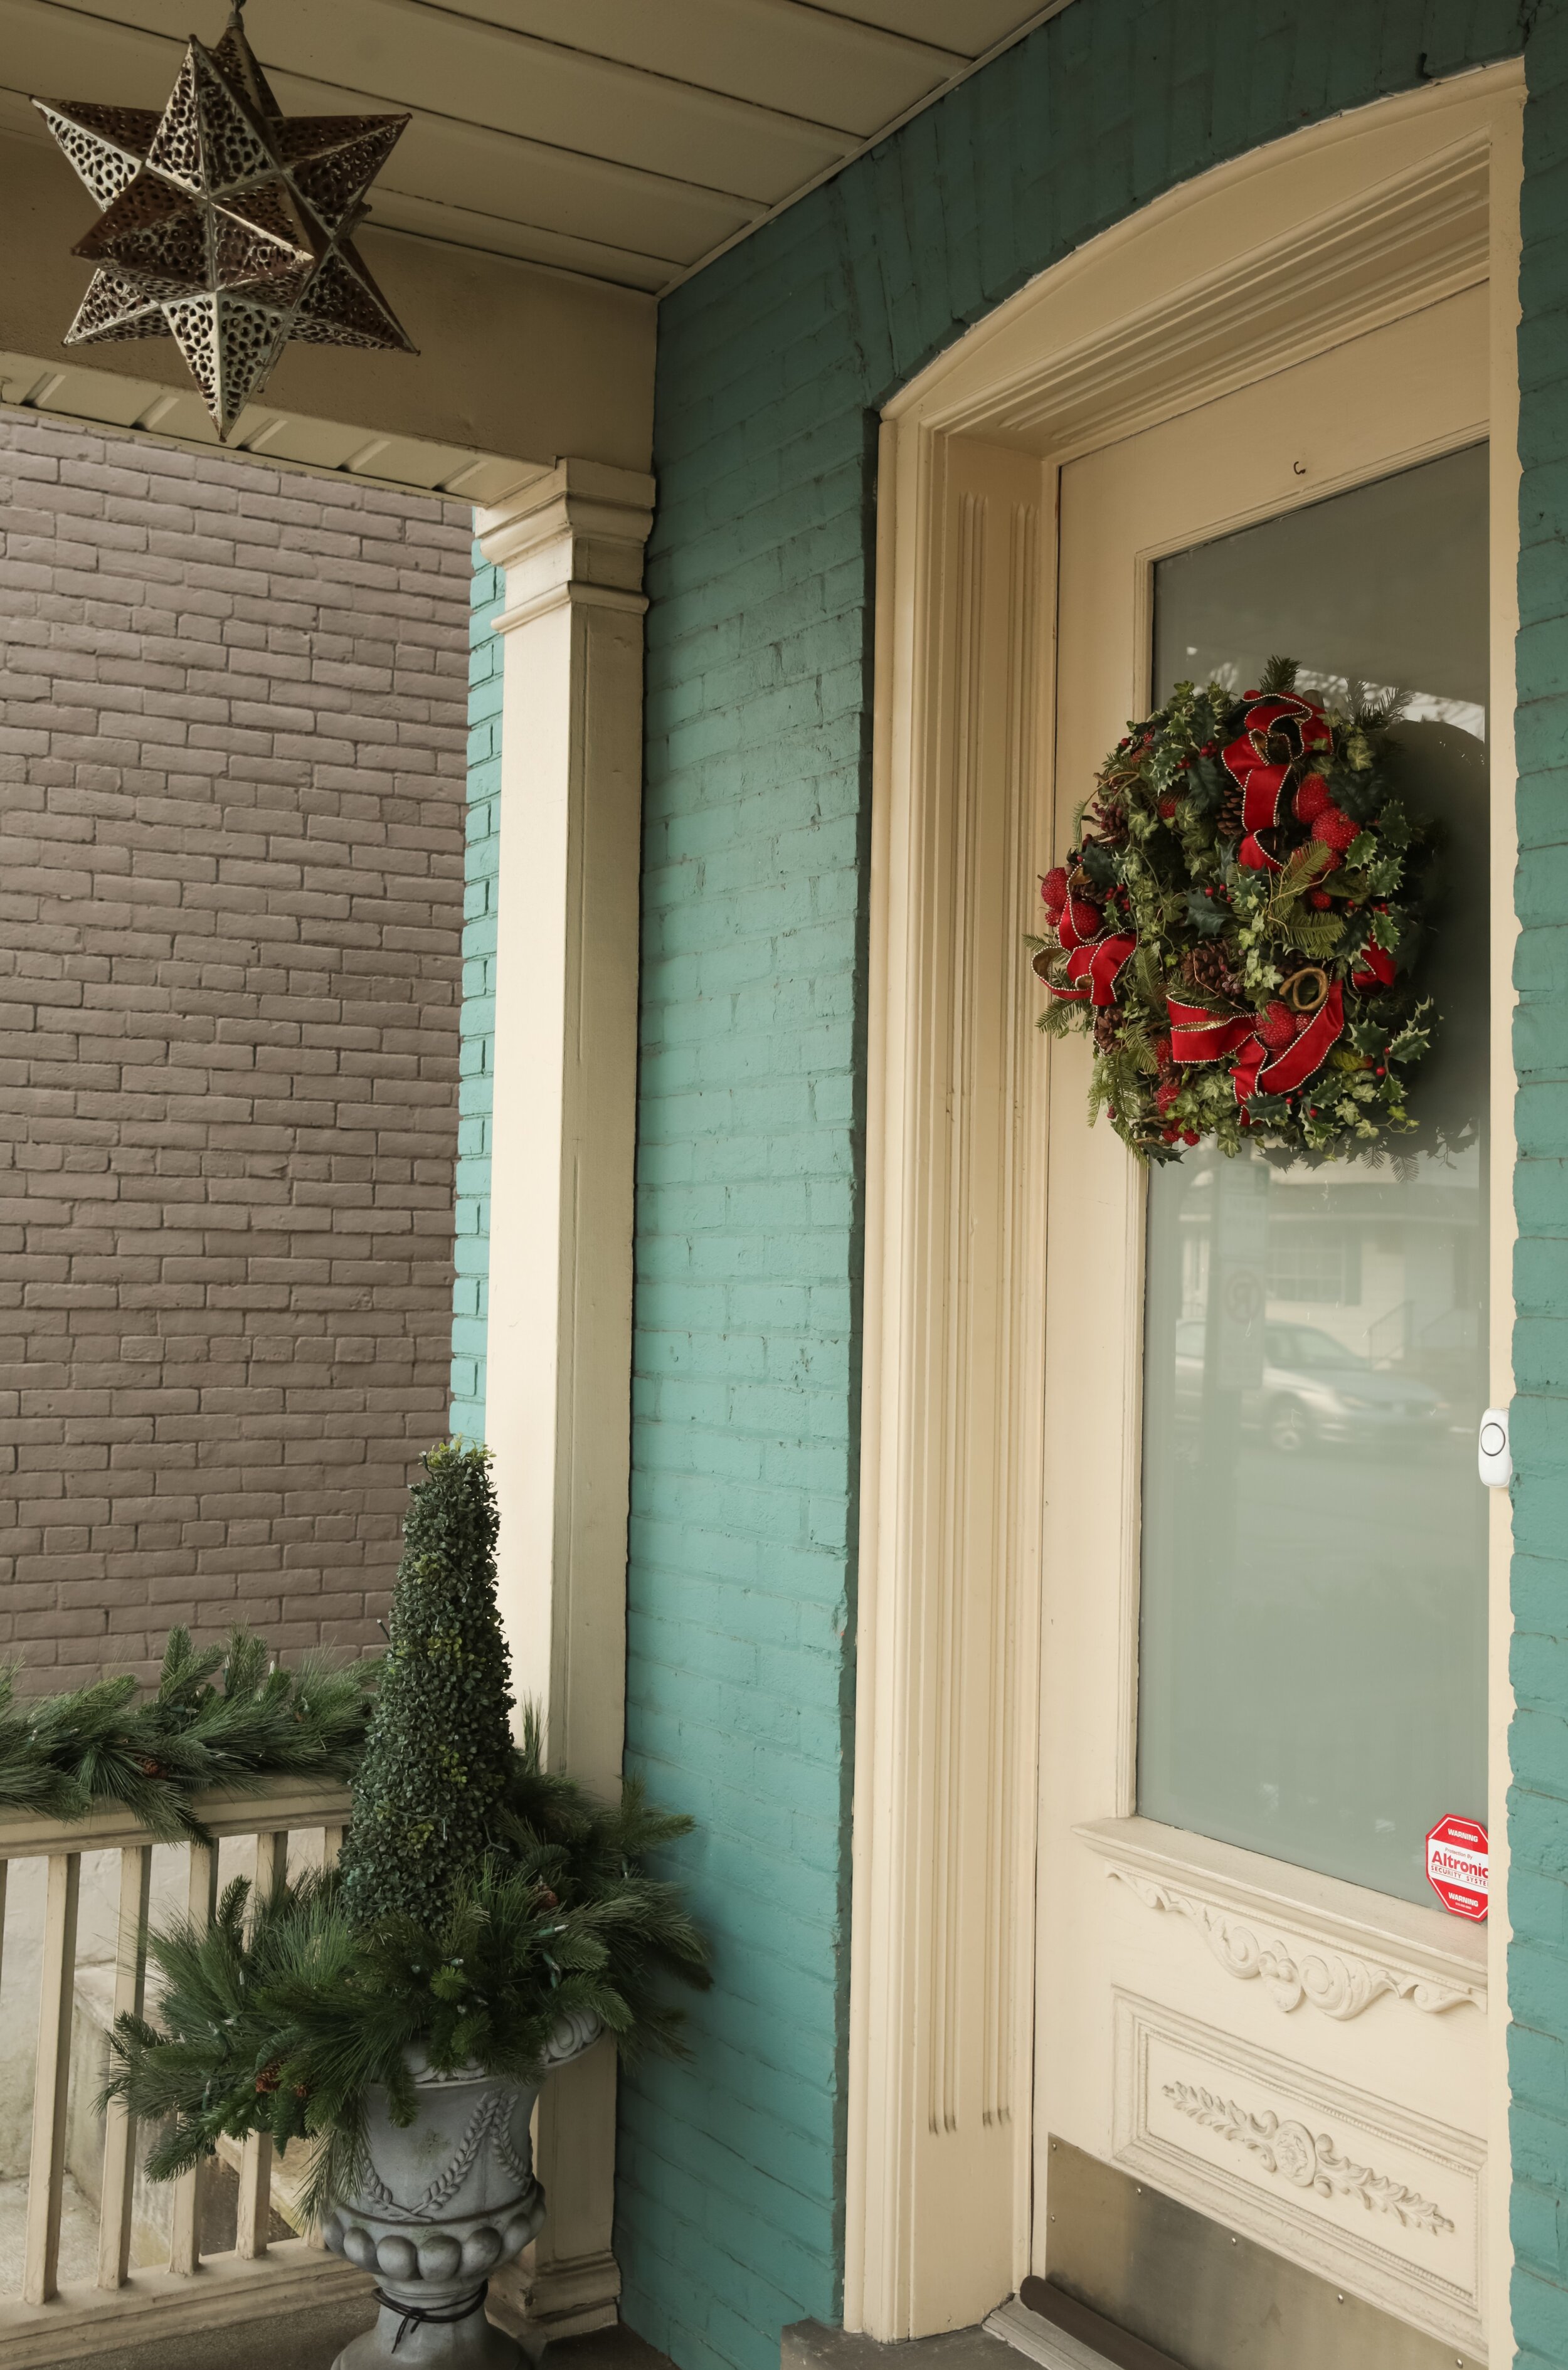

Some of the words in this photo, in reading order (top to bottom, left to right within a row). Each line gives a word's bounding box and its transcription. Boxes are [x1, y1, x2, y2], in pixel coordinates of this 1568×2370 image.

[1448, 1828, 1478, 1843] WARNING
[1444, 1847, 1466, 1858] Protection
[1431, 1865, 1462, 1879] SECURITY
[1466, 1876, 1488, 1888] SYSTE
[1448, 1891, 1479, 1907] WARNING
